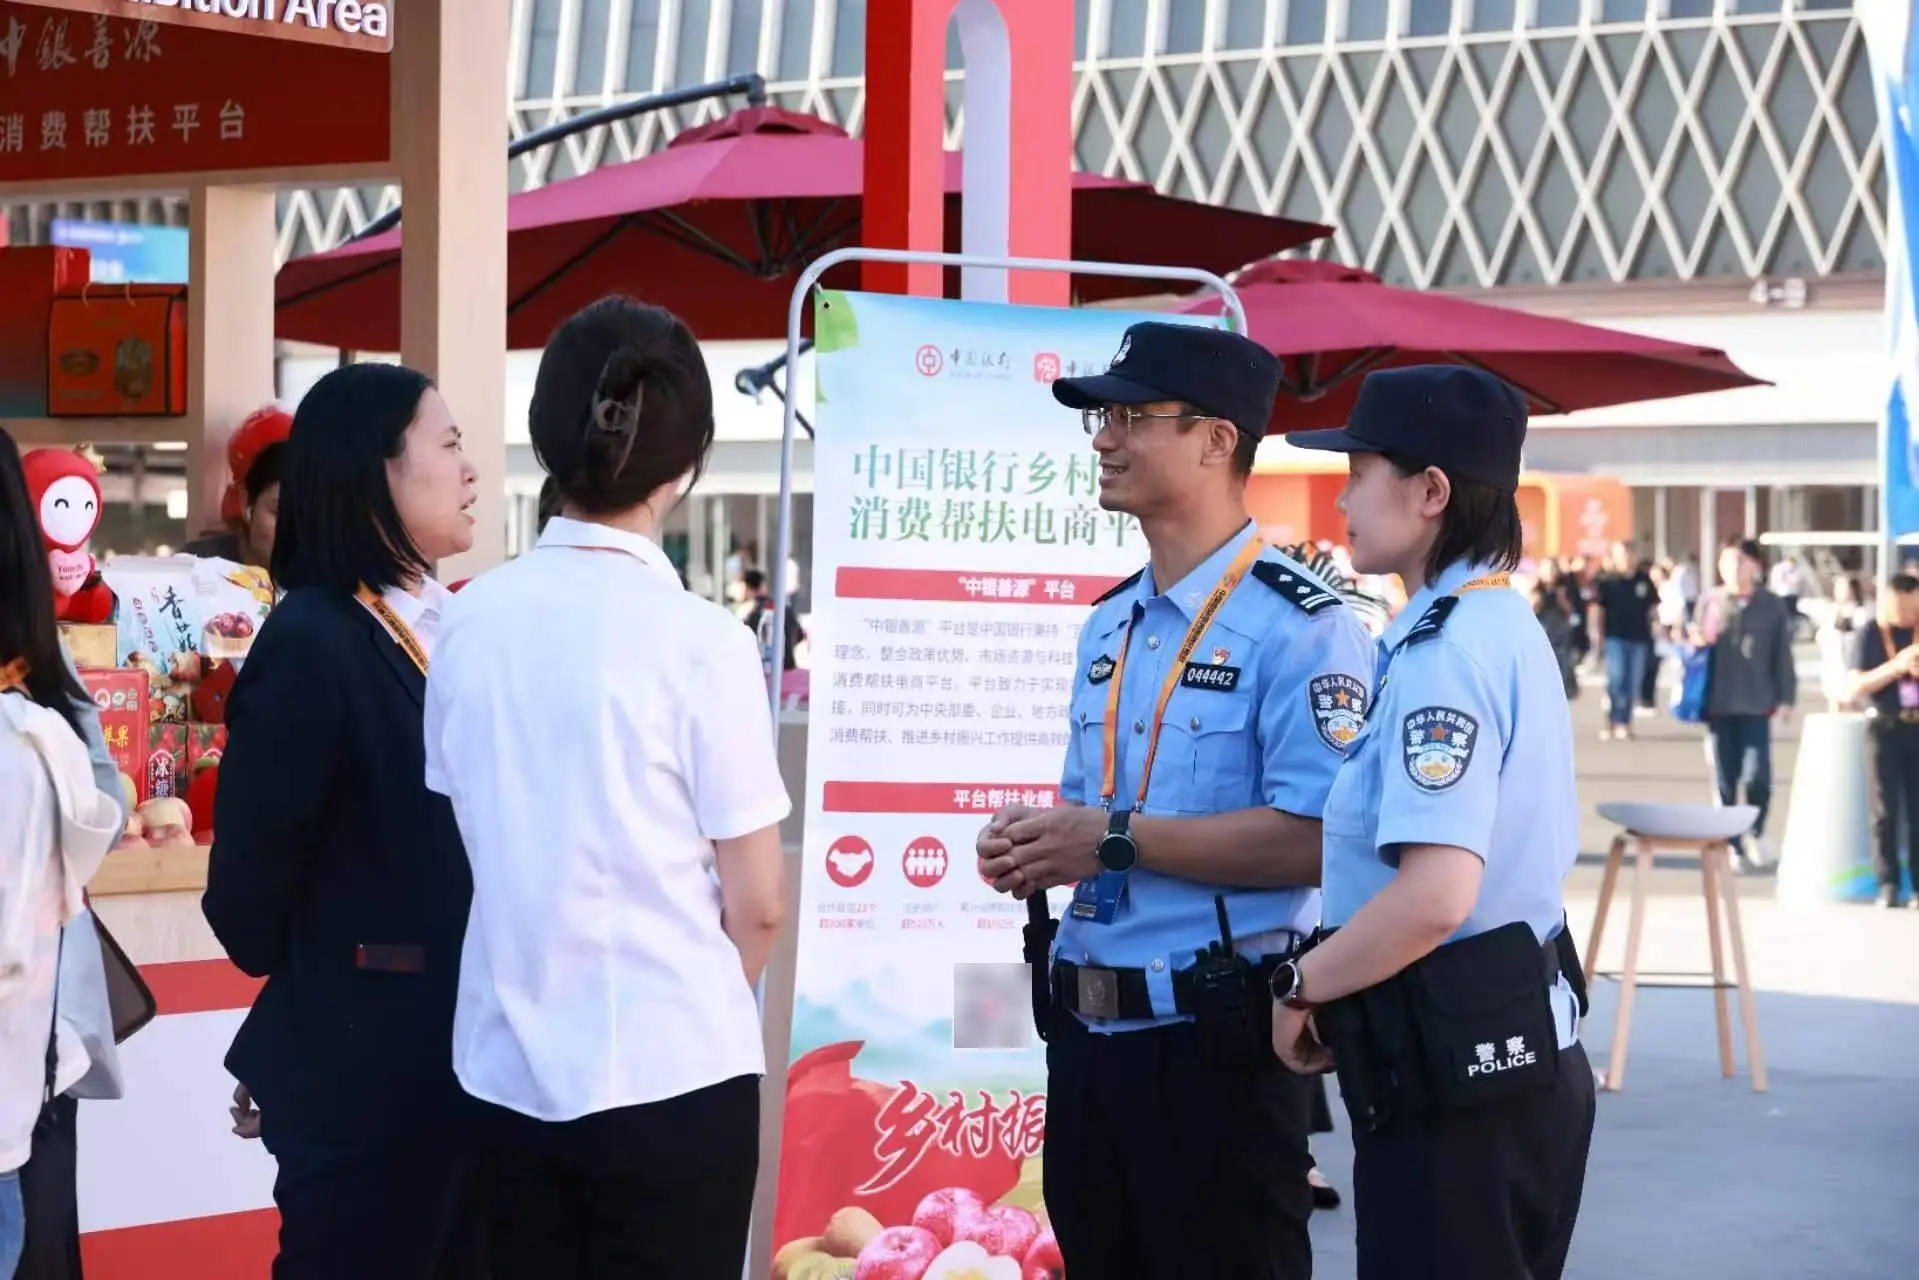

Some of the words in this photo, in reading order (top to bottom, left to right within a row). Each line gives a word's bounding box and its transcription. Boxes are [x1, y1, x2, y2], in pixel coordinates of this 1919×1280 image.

[283, 0, 388, 37] Area
[0, 98, 246, 153] 消费帮扶平台
[853, 444, 1100, 496] 中国银行乡村
[849, 495, 1139, 548] 消费帮扶电商平
[1187, 667, 1234, 686] 044442
[1467, 1051, 1537, 1077] POLICE
[1475, 1035, 1525, 1063] 警察
[853, 1079, 1047, 1195] 乡村振
